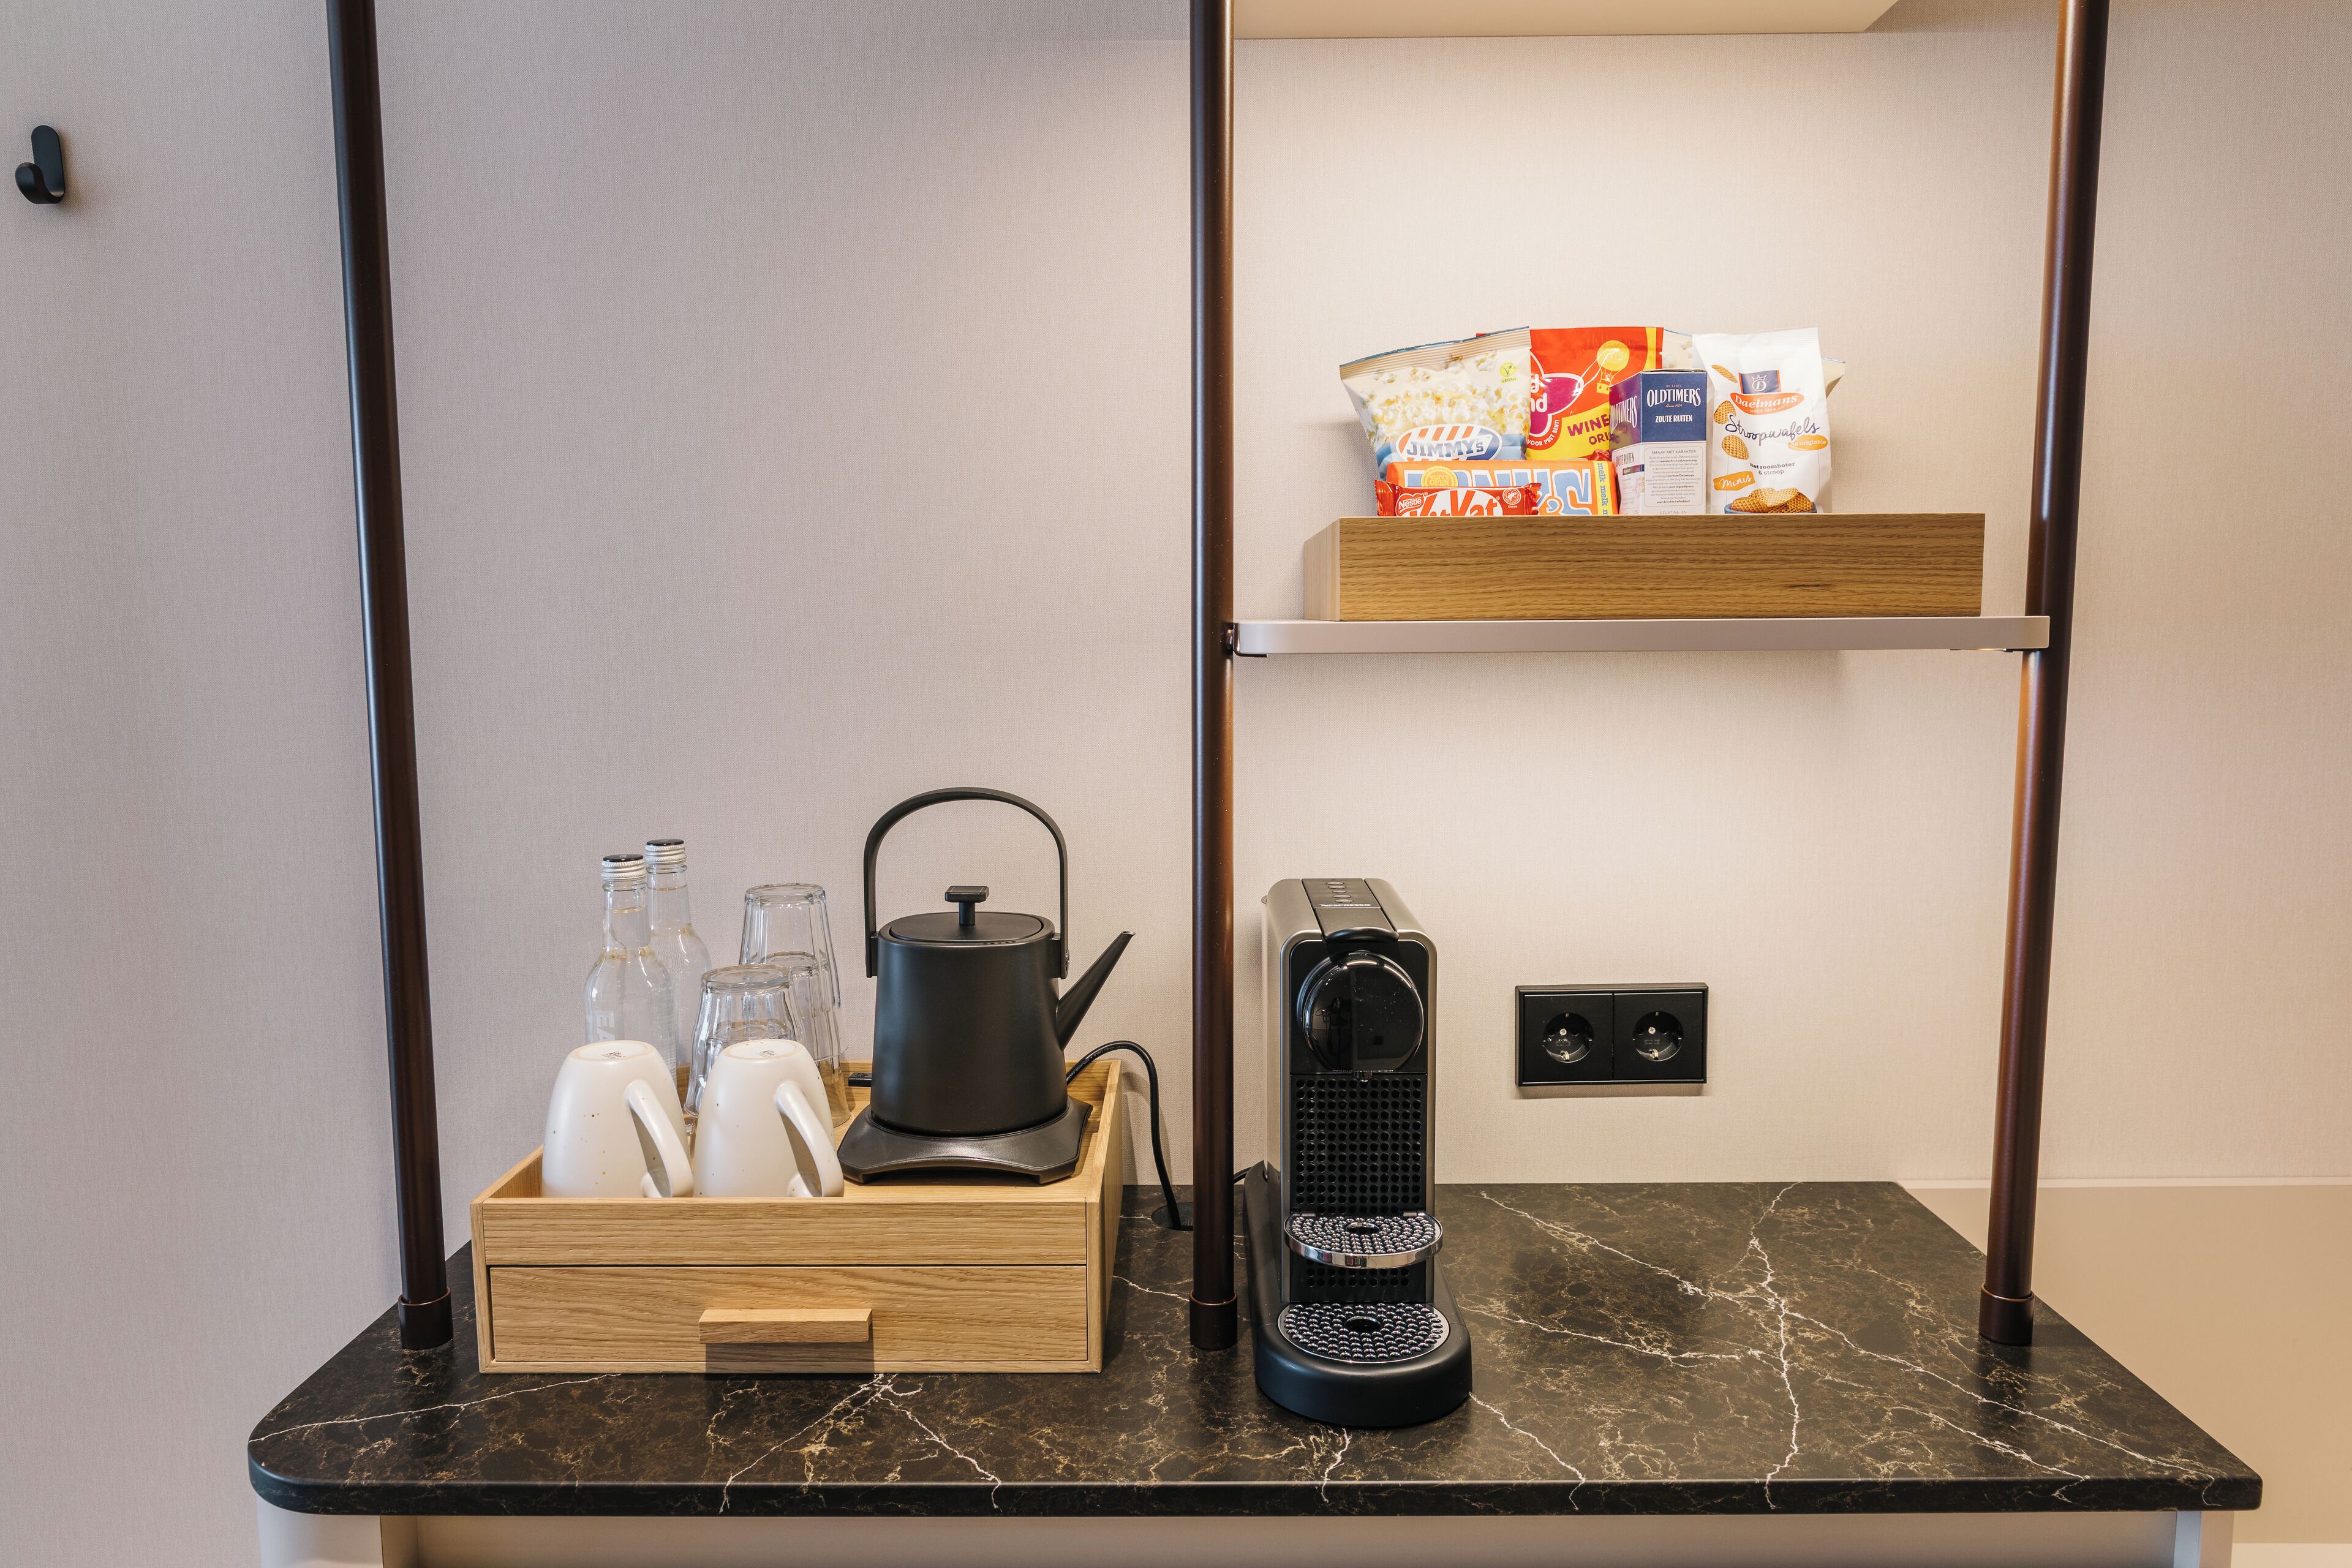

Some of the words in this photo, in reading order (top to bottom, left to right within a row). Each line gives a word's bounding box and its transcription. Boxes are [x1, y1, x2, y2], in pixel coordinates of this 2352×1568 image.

[1646, 388, 1702, 407] OLDTIMERS
[1735, 394, 1798, 408] Daelmans
[1610, 396, 1638, 434] OLDTIMERS
[1725, 414, 1820, 446] Stroopwafels
[1544, 434, 1555, 445] PRET
[1589, 432, 1609, 445] ORI
[1799, 439, 1826, 447] originele
[1719, 474, 1752, 489] Minis
